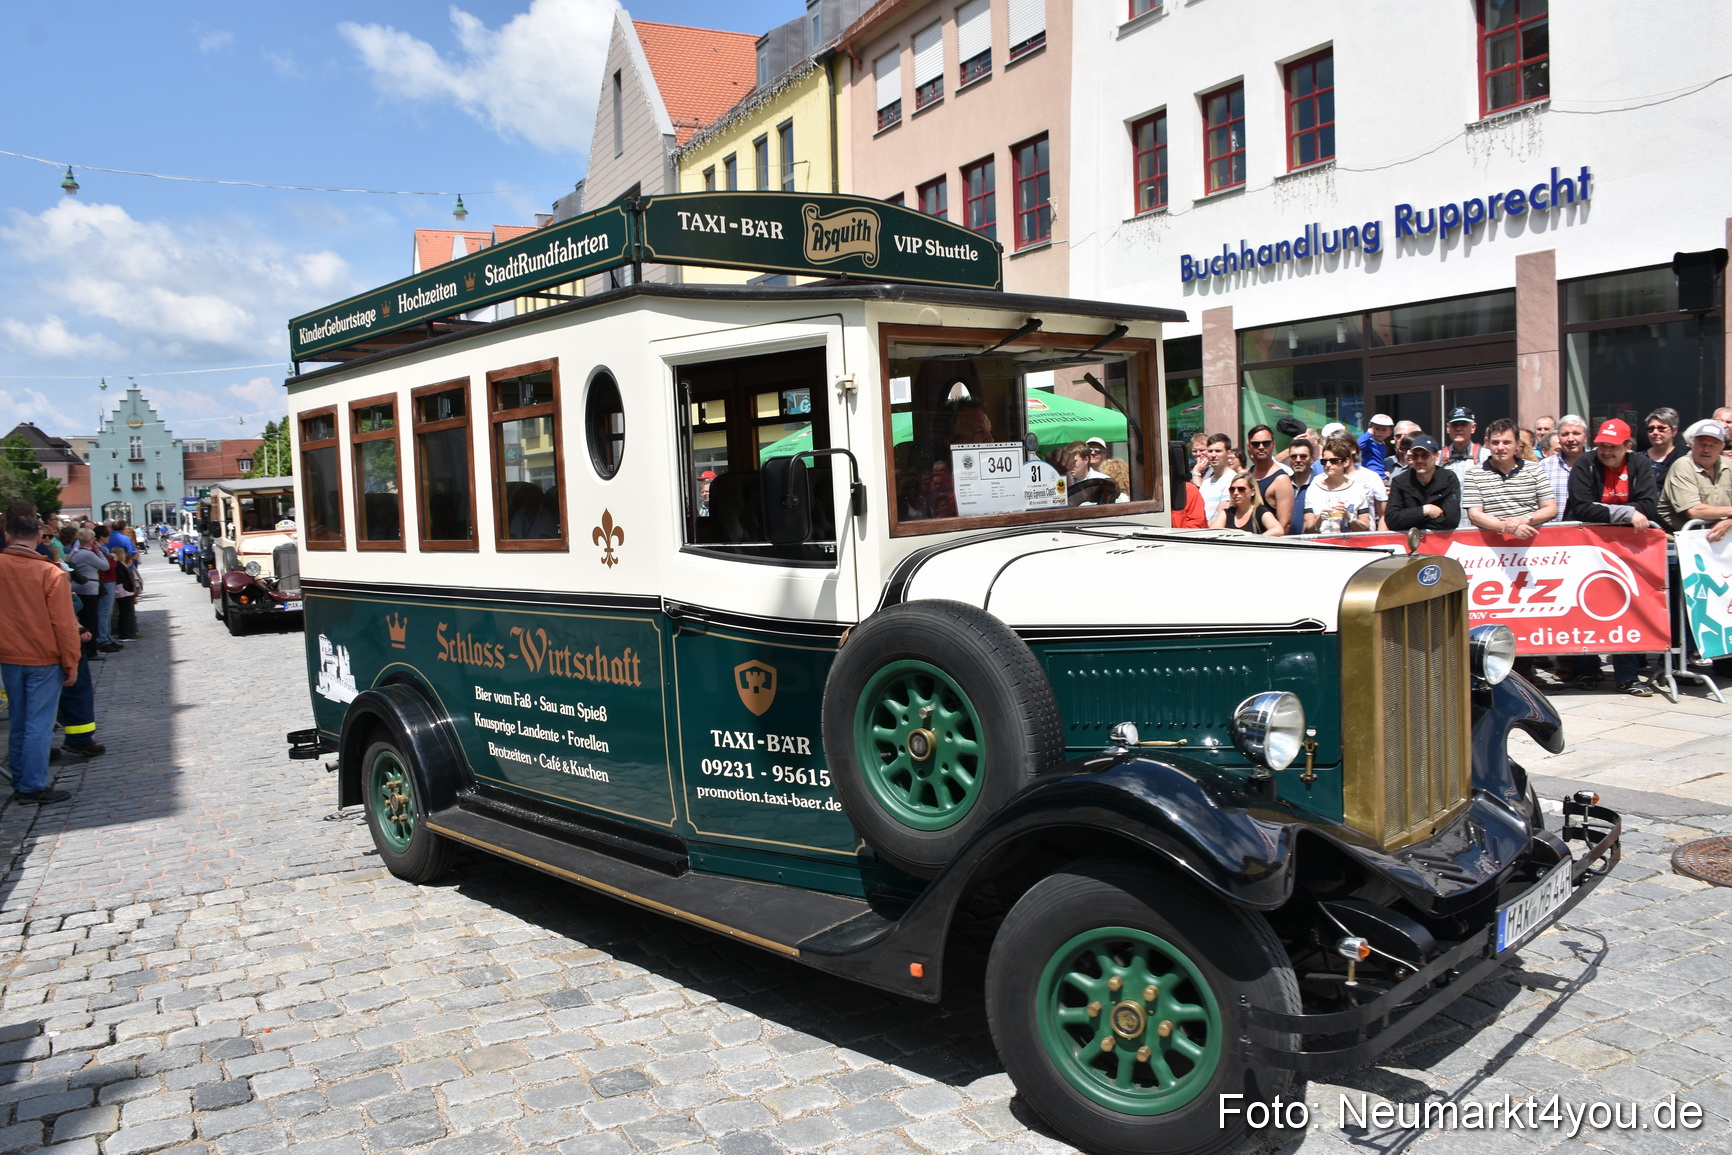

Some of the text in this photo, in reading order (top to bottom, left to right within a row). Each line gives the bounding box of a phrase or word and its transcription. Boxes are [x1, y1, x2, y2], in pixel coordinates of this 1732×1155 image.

[677, 211, 784, 240] TAXI-BÄR
[812, 217, 872, 253] Asquith
[1180, 165, 1595, 283] Buchhandlung Rupprecht
[894, 234, 979, 262] VIP Shuttle
[299, 233, 609, 345] KinderGeburtstage Hochzeiten StadtRundfahrten
[1028, 416, 1095, 425] ammsbräu
[988, 456, 1012, 473] 340
[1030, 465, 1041, 483] 31
[1456, 551, 1572, 569] utoklassik
[1467, 571, 1565, 606] etz
[437, 621, 642, 687] Schloss-Wirtschaft
[474, 685, 608, 723] Bier vom Faß Sau am Spieß
[474, 712, 610, 753] Knusprige Landente Forellen
[710, 729, 812, 755] TAXI-BÄR
[488, 741, 532, 765] Brotzeiten
[539, 753, 561, 773] Café
[701, 758, 755, 779] 09231
[771, 765, 831, 787] 95615
[696, 786, 842, 812] promotion.taxi-baer.de
